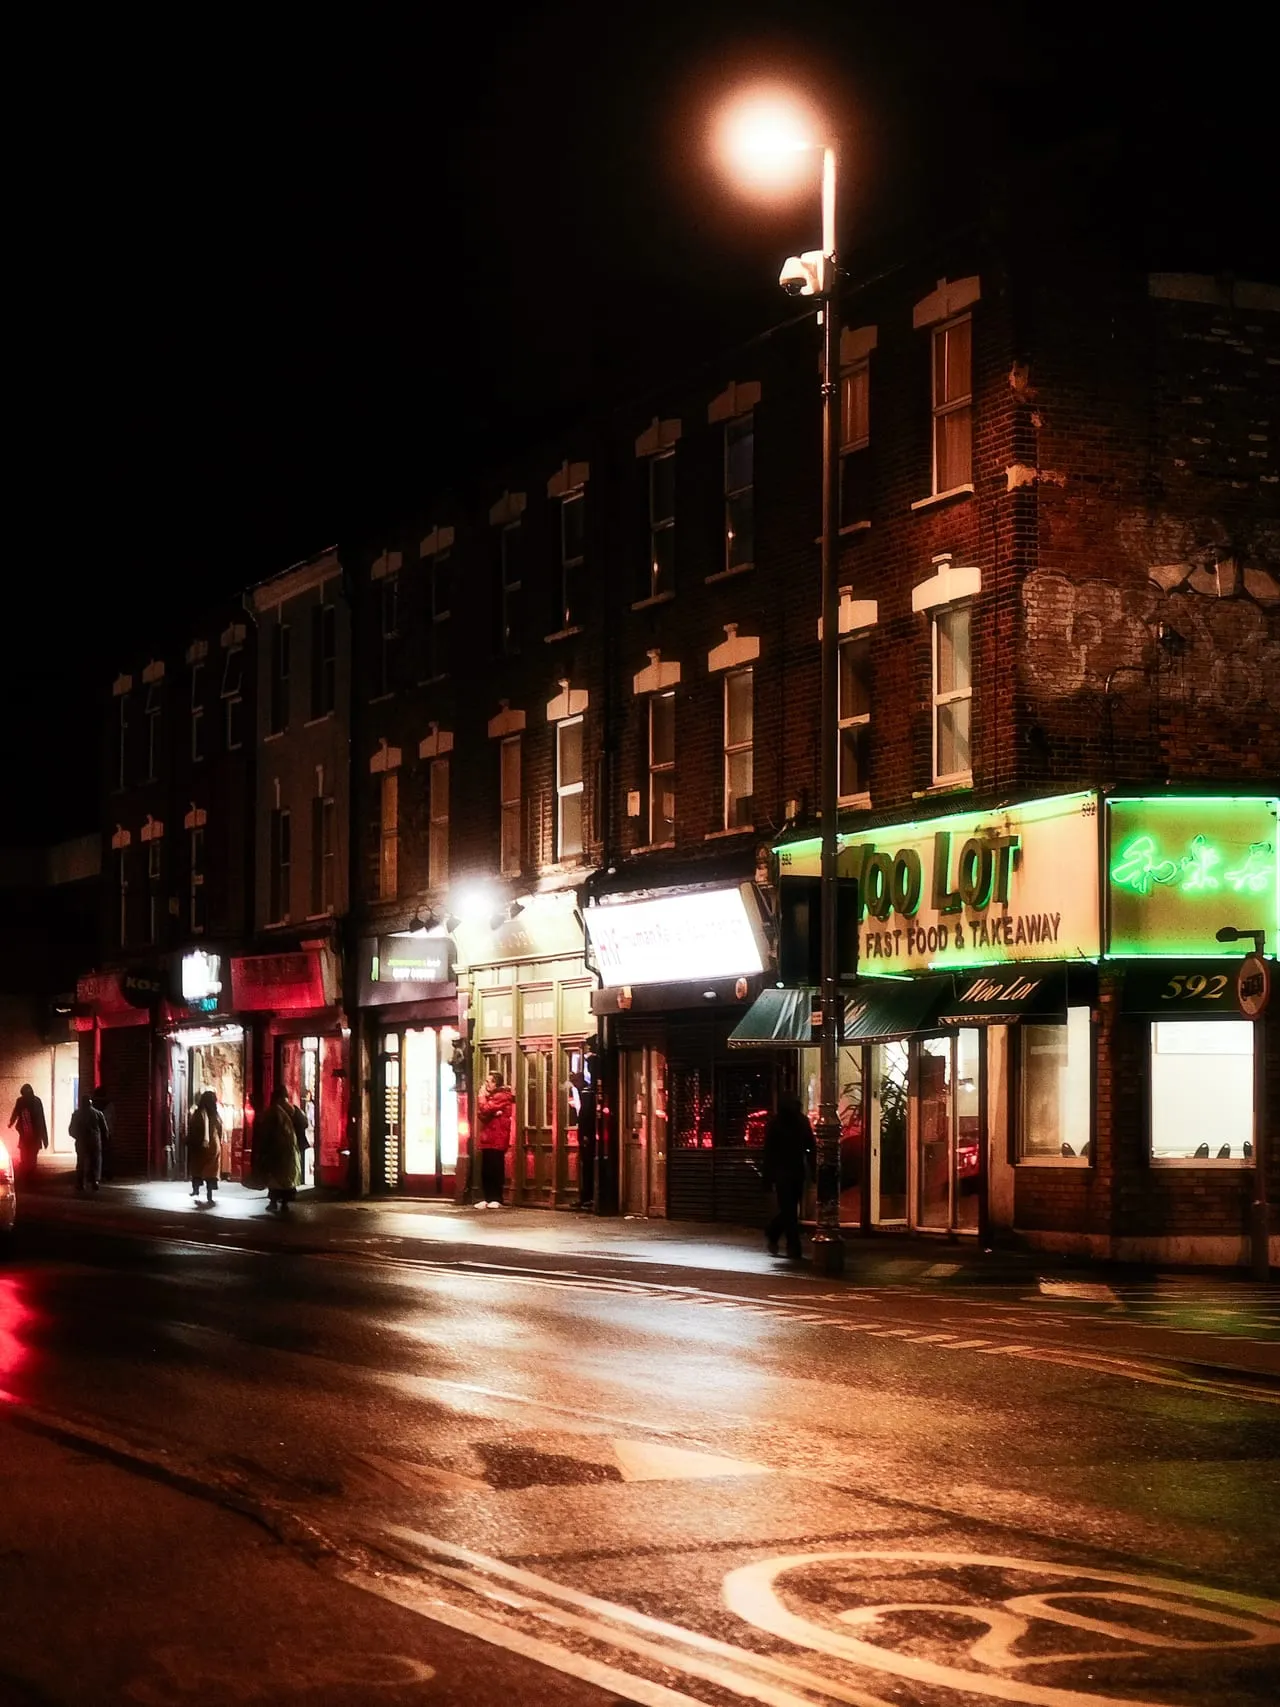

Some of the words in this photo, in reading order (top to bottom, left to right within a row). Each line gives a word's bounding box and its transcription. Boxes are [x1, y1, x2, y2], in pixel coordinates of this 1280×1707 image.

[931, 831, 1021, 915] LOT
[866, 928, 902, 959] FAST
[908, 922, 949, 955] FOOD
[954, 923, 965, 949] &
[959, 978, 1004, 1002] Woo
[996, 976, 1043, 1001] Lot
[1160, 974, 1228, 1000] 592
